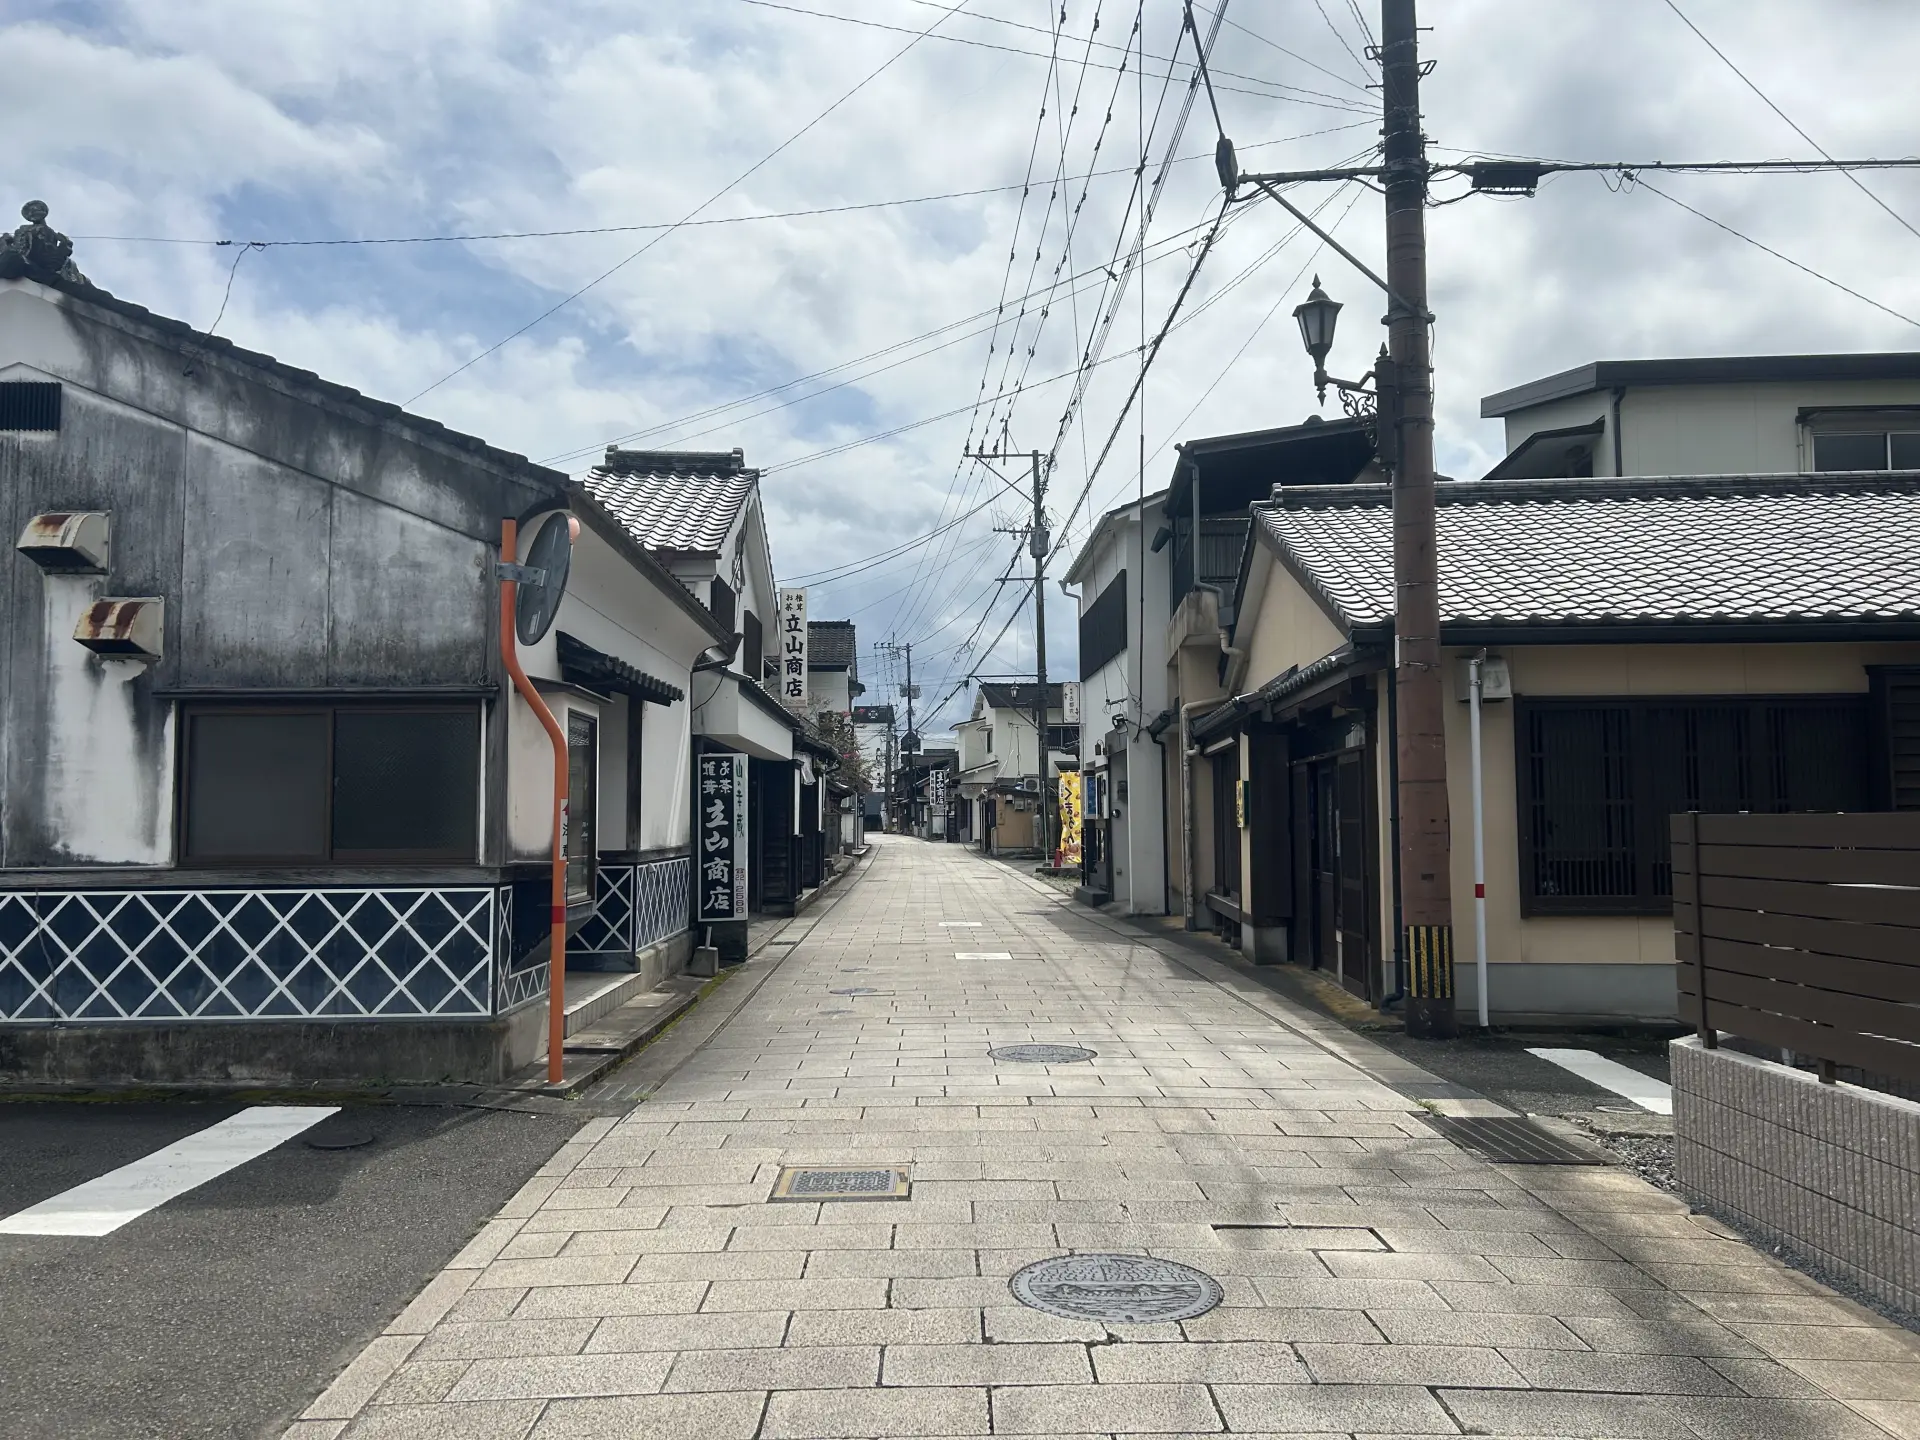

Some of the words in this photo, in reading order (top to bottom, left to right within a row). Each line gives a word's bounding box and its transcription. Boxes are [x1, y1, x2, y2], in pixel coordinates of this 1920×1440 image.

[785, 594, 793, 611] お茶
[784, 614, 803, 697] 立山商店
[702, 761, 718, 795] 椎茸
[719, 761, 732, 794] お茶
[703, 799, 731, 911] 立山商店
